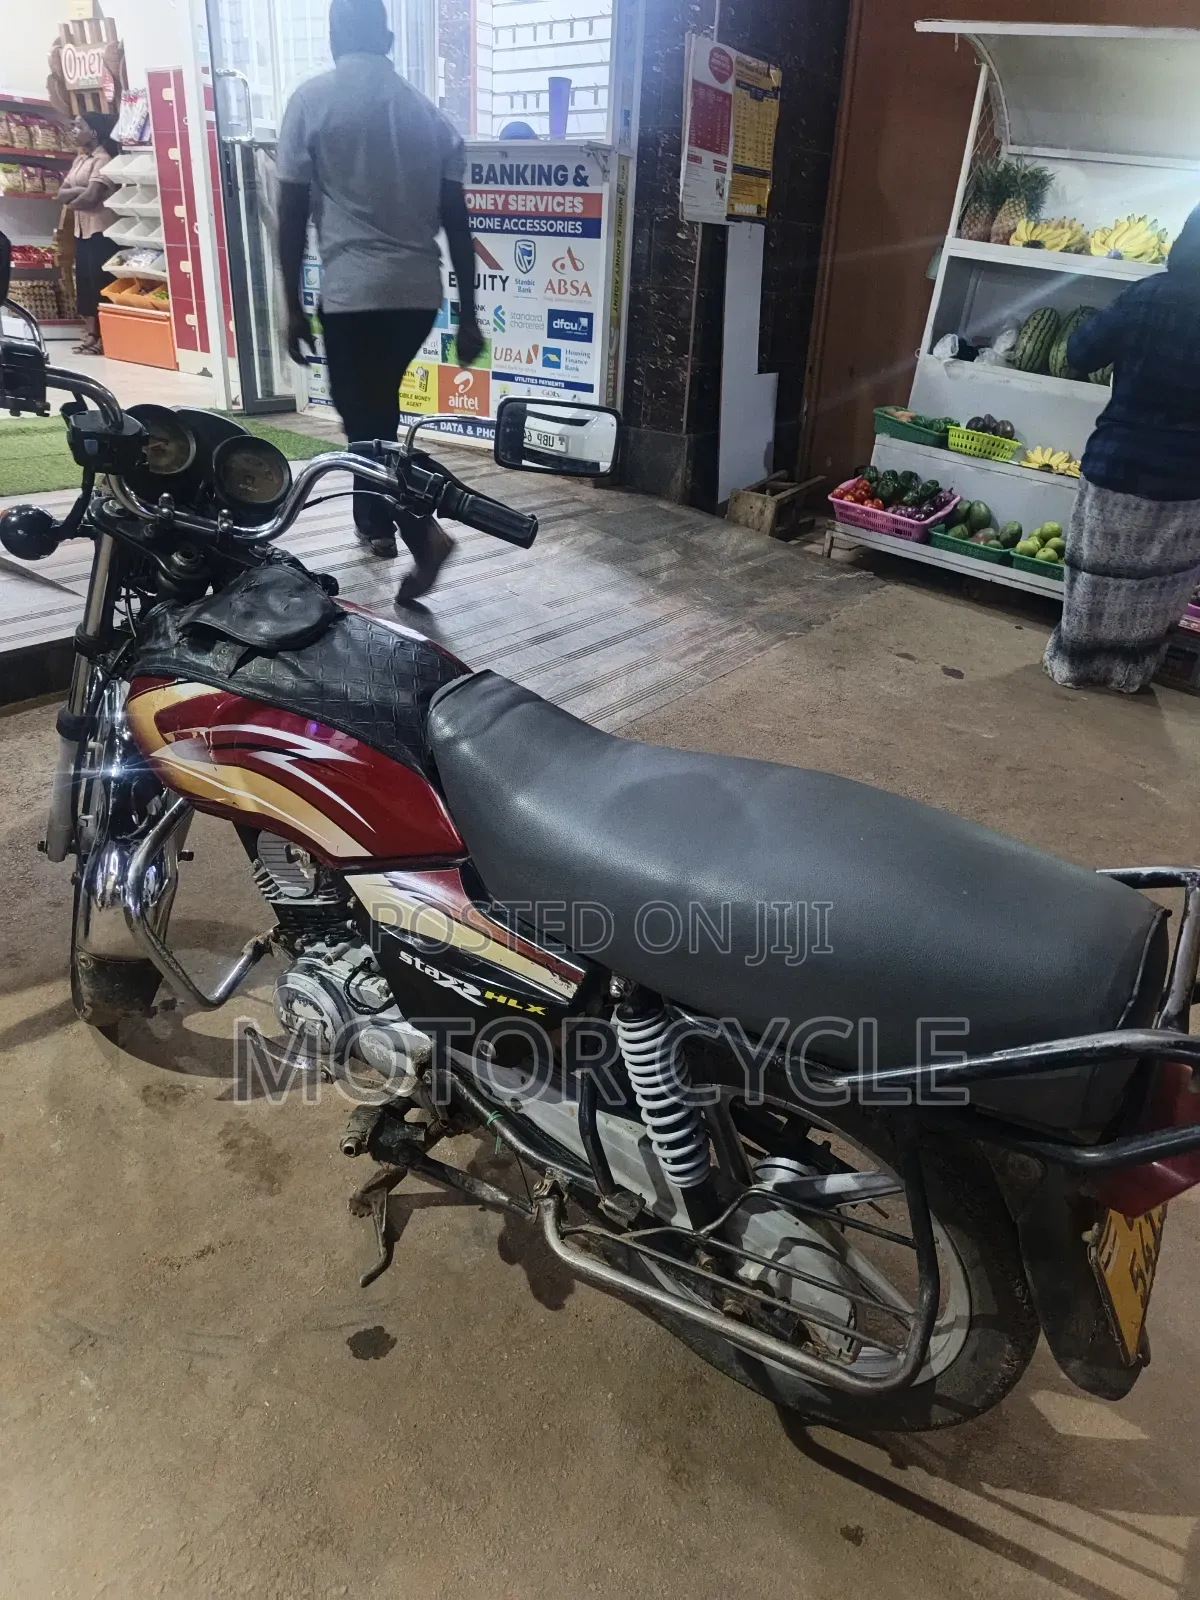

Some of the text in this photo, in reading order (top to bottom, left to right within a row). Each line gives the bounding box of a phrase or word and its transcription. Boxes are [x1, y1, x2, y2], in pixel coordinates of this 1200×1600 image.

[471, 163, 590, 187] BANKING &
[464, 193, 584, 213] ONEY SERVICES
[468, 216, 583, 234] HONE ACCESSORIES
[448, 271, 510, 292] EUITY
[514, 278, 536, 287] Stanbic
[543, 278, 593, 298] ABSA
[517, 286, 533, 294] Bank
[474, 303, 486, 312] ANK
[509, 312, 543, 322] standard
[509, 319, 545, 331] chartered
[552, 318, 578, 331] dfcu
[423, 347, 439, 356] Bank
[493, 346, 523, 364] UBA
[565, 349, 591, 359] Housing
[565, 358, 589, 366] Finance
[564, 365, 580, 373] Bank
[514, 375, 565, 388] UTILITIES PAYMENTS
[448, 392, 480, 411] airtel
[440, 421, 464, 434] DATA
[466, 426, 474, 435] &
[476, 427, 496, 438] PHO
[483, 990, 547, 1016] HLX
